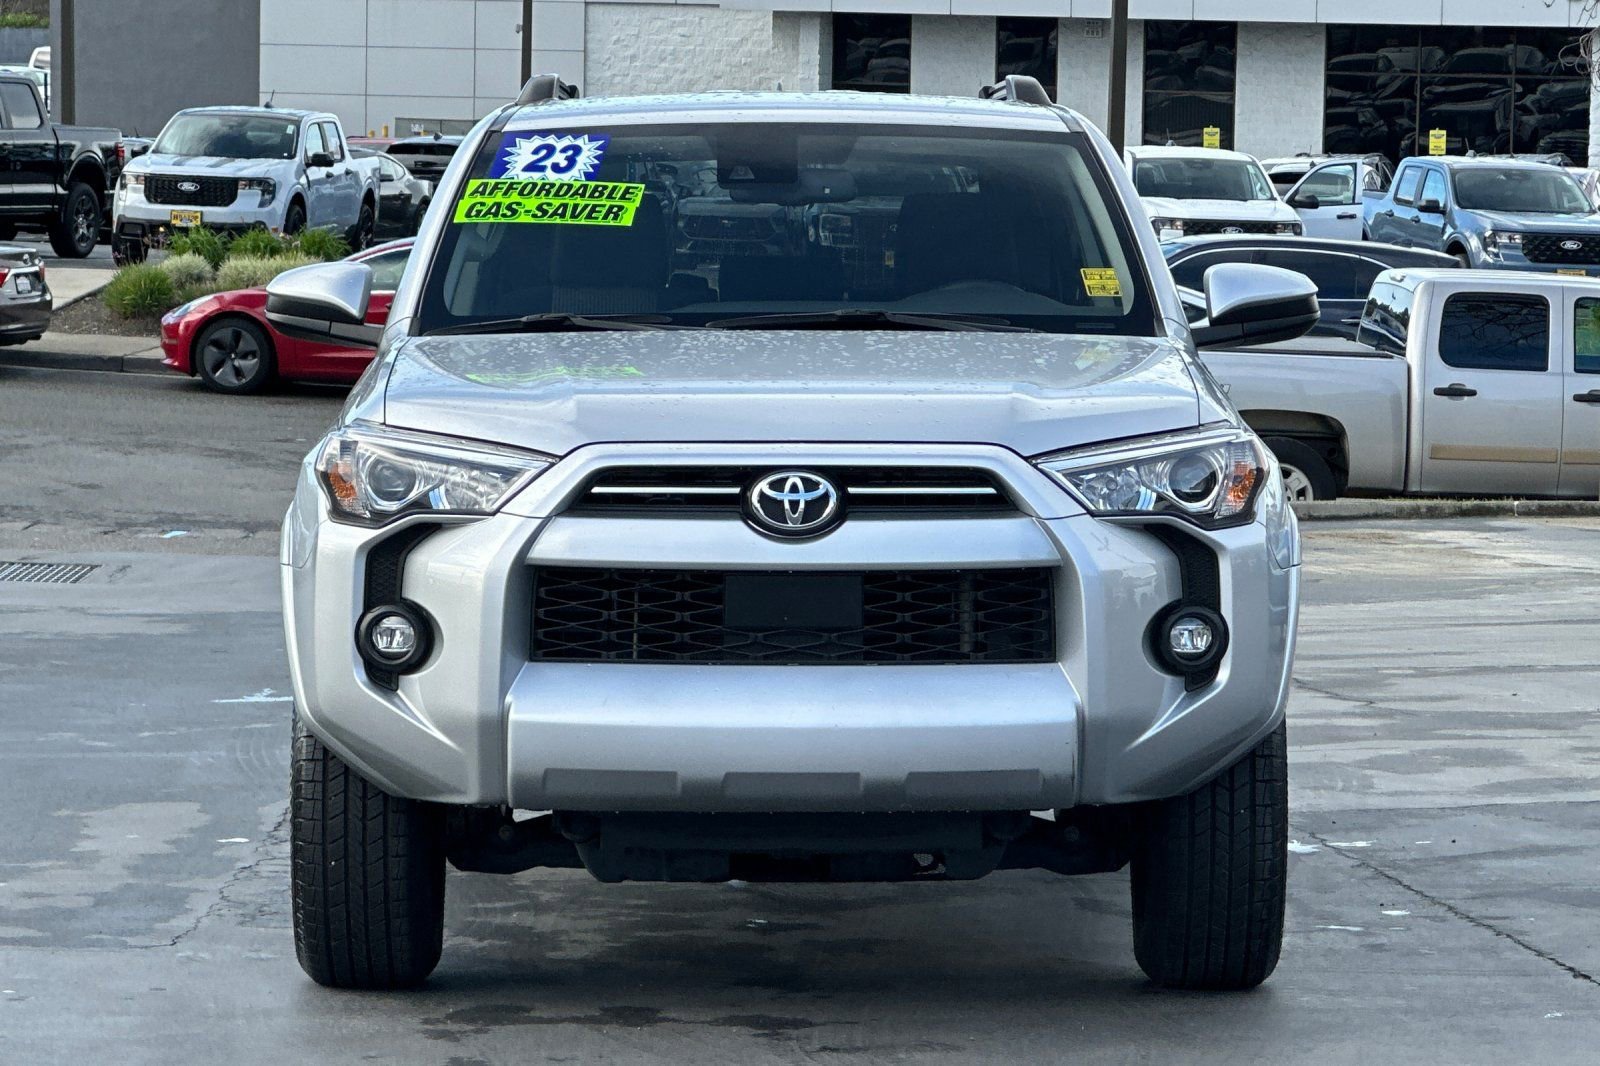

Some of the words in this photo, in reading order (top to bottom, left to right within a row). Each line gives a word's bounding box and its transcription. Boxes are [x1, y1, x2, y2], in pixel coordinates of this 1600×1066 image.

[521, 143, 583, 174] 23
[468, 181, 641, 202] AFFORDABLE
[464, 201, 627, 223] GAS-SAVER
